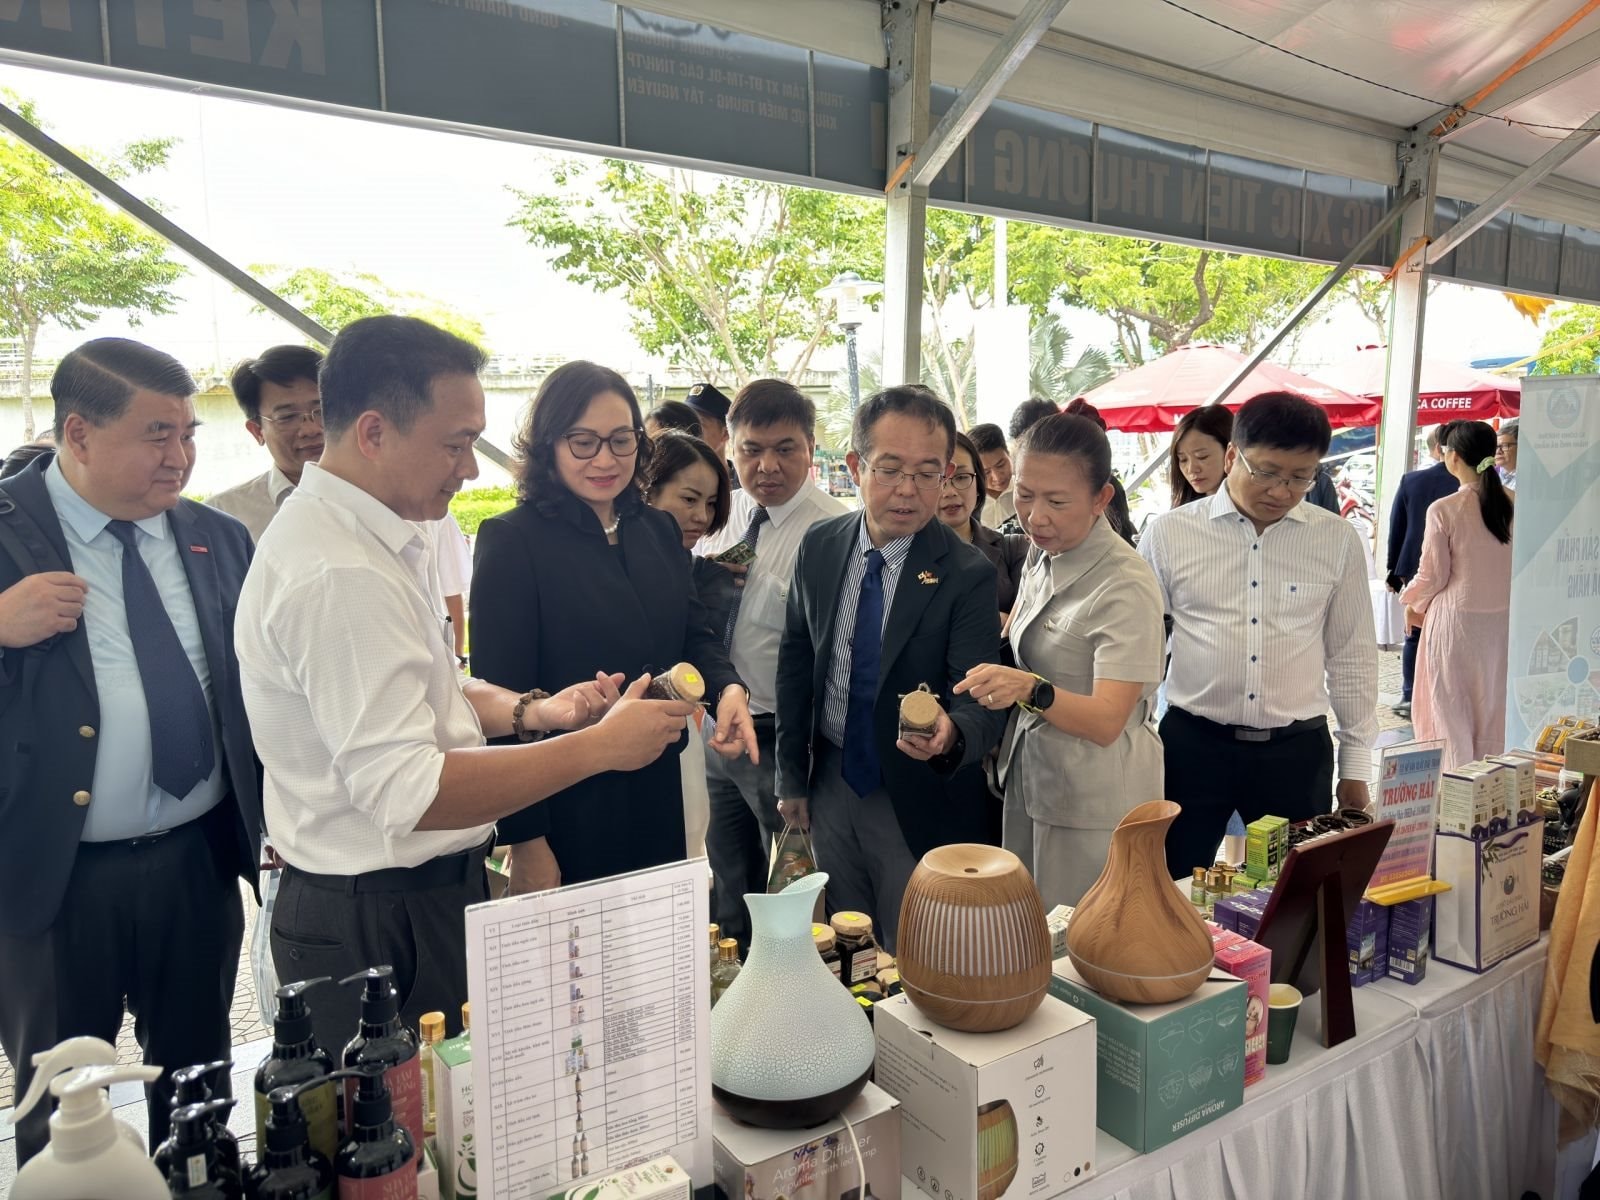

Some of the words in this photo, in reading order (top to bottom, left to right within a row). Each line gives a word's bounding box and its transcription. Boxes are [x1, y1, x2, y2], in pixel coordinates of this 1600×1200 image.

[1430, 397, 1472, 410] COFFEE
[1201, 1099, 1226, 1117] AROMA
[1172, 1111, 1201, 1132] DIFFUSER
[772, 1157, 818, 1184] Aroma
[822, 1134, 872, 1163] Diffuer
